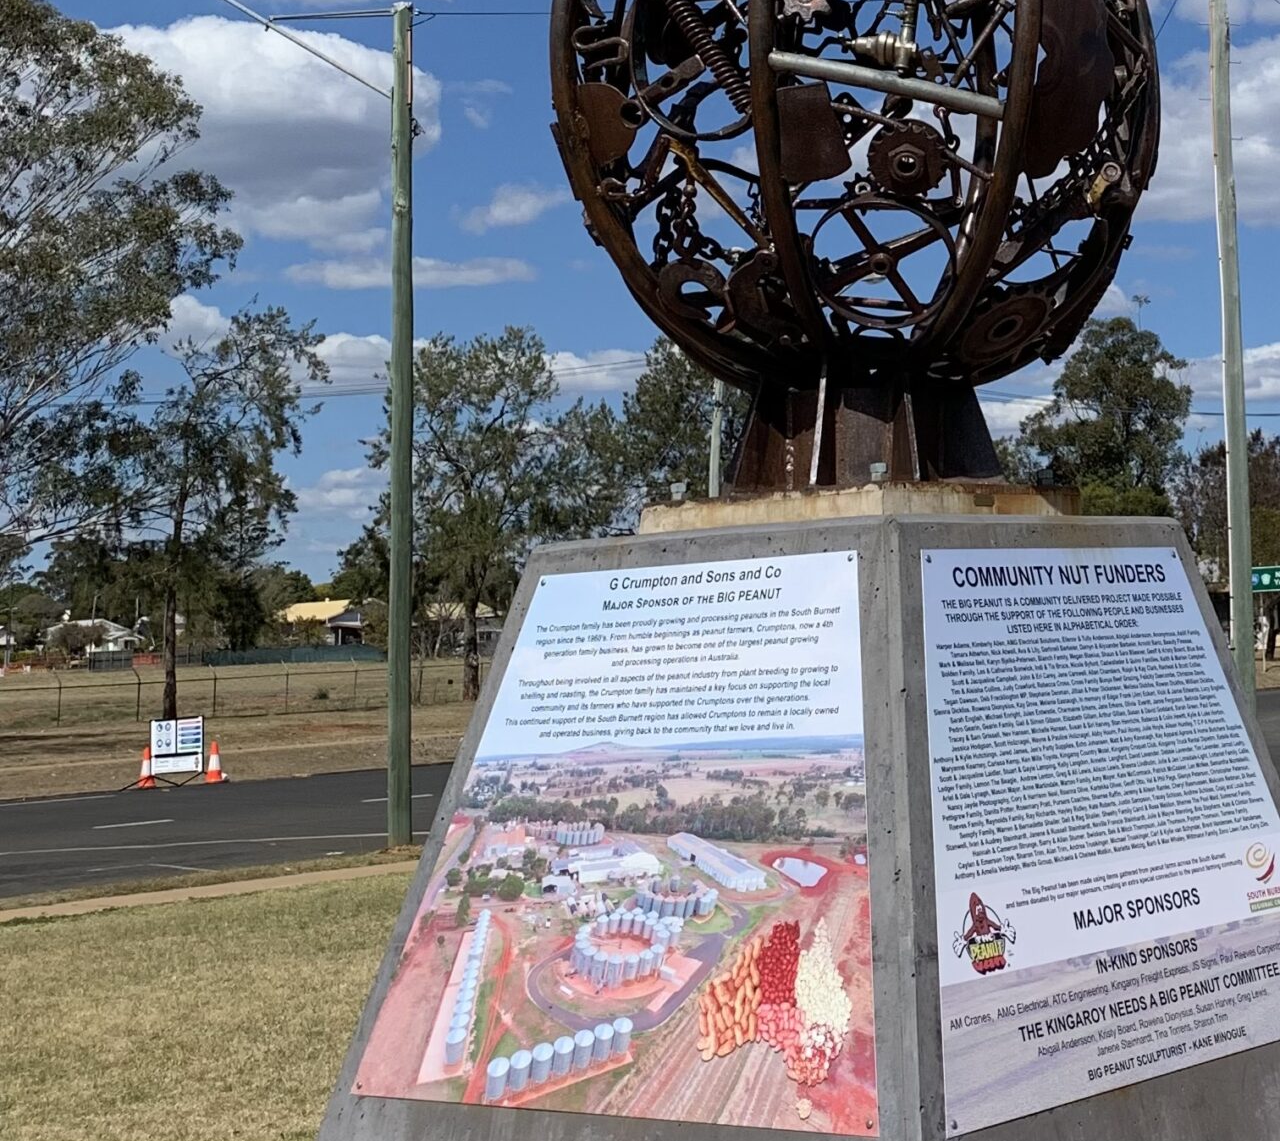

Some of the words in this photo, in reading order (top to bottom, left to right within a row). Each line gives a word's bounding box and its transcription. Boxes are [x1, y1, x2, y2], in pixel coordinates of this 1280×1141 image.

[609, 577, 618, 590] G
[621, 576, 677, 589] Crumpton
[680, 571, 703, 585] and
[705, 570, 735, 583] Sons
[739, 566, 762, 580] and
[765, 565, 781, 579] Co
[953, 566, 1053, 587] COMMUNITY
[1058, 565, 1089, 584] NUT
[1094, 564, 1165, 583] FUNDERS
[602, 600, 633, 610] MAJOR
[636, 597, 679, 608] SPONSOR
[682, 596, 694, 605] OF
[697, 594, 714, 604] THE
[717, 591, 735, 603] BIG
[738, 587, 781, 601] PEANUT
[941, 599, 957, 609] THE
[958, 598, 972, 609] BIG
[973, 597, 1002, 608] PEANUT
[1004, 597, 1012, 607] IS
[1013, 597, 1019, 606] A
[1019, 596, 1061, 606] COMMUNITY
[1062, 594, 1100, 605] DELIVERED
[1101, 593, 1130, 603] PROJECT
[1131, 593, 1151, 602] MADE
[945, 612, 983, 622] THROUGH
[984, 611, 1000, 621] THE
[1000, 610, 1034, 620] SUPPORT
[1035, 609, 1045, 619] OF
[1046, 608, 1062, 618] THE
[1062, 607, 1103, 617] FOLLOWING
[1103, 606, 1130, 616] PEOPLE
[1130, 605, 1144, 614] AND
[1145, 604, 1184, 614] BUSINESSES
[549, 624, 580, 632] Crumpton
[1006, 623, 1032, 634] LISTED
[1033, 622, 1053, 632] HERE
[1053, 622, 1062, 631] IN
[1063, 620, 1113, 631] ALPHABETICAL
[1246, 889, 1266, 899] SOUTH
[1073, 903, 1124, 929] MAJOR
[1126, 888, 1200, 918] SPONSORS
[970, 940, 1005, 962] PEANUT
[1095, 951, 1137, 973] IN-KIND
[1139, 937, 1197, 963] SPONSORS
[1018, 1021, 1044, 1041] THE
[1045, 1006, 1105, 1034] KINGAROY
[1109, 996, 1147, 1018] NEEDS
[1149, 993, 1158, 1009] A
[1158, 988, 1178, 1005] BIG
[1179, 976, 1220, 1000] PEANUT
[1223, 962, 1280, 988] COMMITTEE
[1087, 1067, 1103, 1081] BIG
[1103, 1057, 1134, 1075] PEANUT
[1136, 1042, 1186, 1066] SCULPTURIST
[1192, 1035, 1213, 1050] KANE
[1213, 1026, 1246, 1043] MINOGUE
